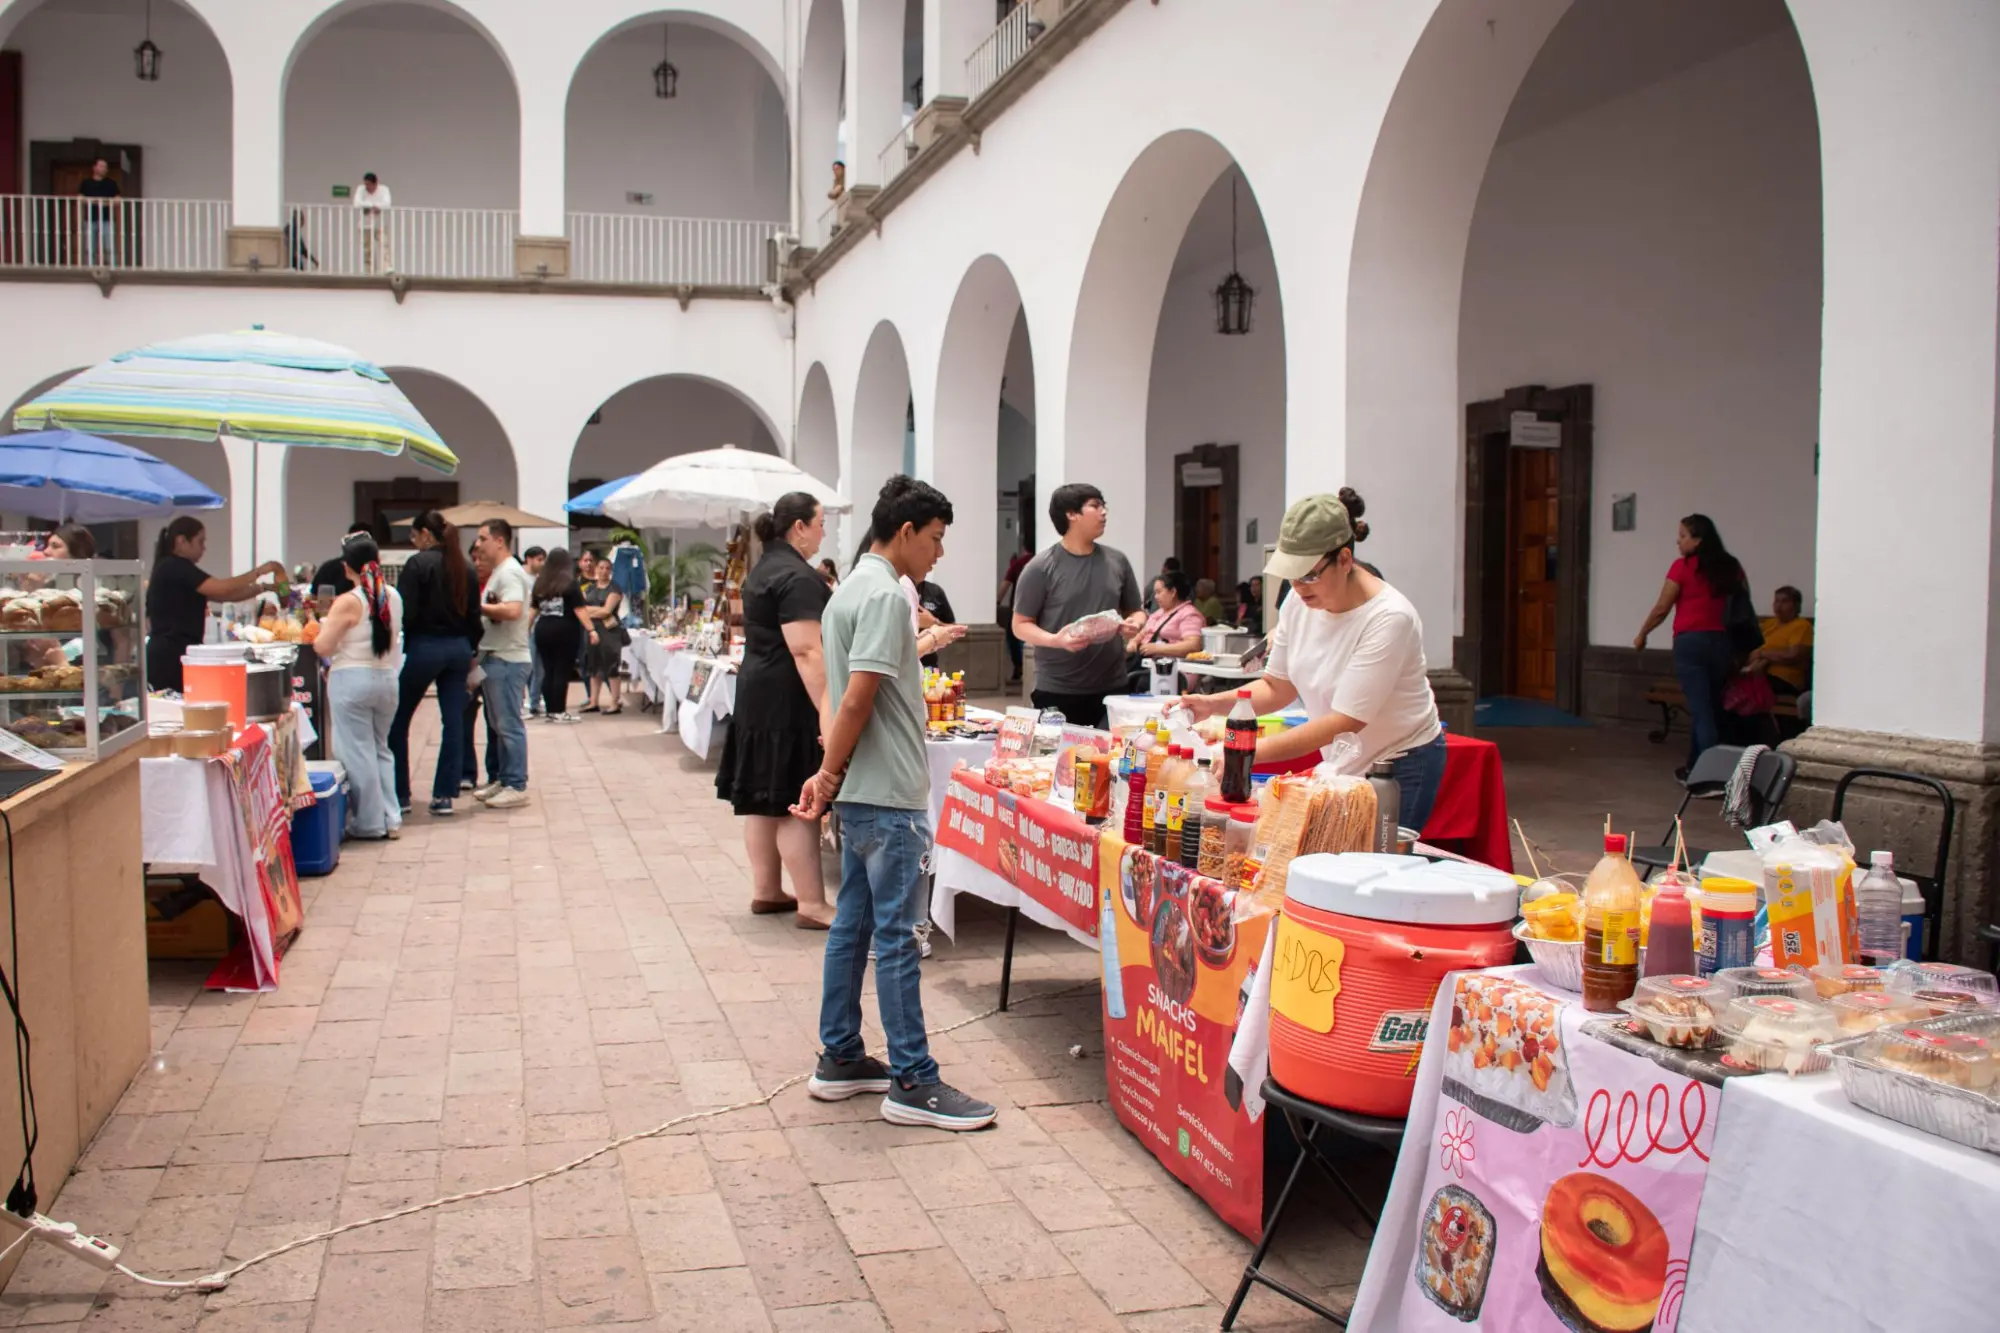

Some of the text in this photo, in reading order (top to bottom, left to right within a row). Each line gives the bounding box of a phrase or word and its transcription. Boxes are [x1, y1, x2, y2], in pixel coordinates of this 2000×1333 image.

[1051, 833, 1080, 860] papas
[1381, 813, 1389, 854] ANORTE
[1786, 932, 1797, 954] 250
[1274, 934, 1337, 994] ADOS
[1136, 1004, 1209, 1085] MAIFEL
[1177, 1103, 1204, 1134] Servicio
